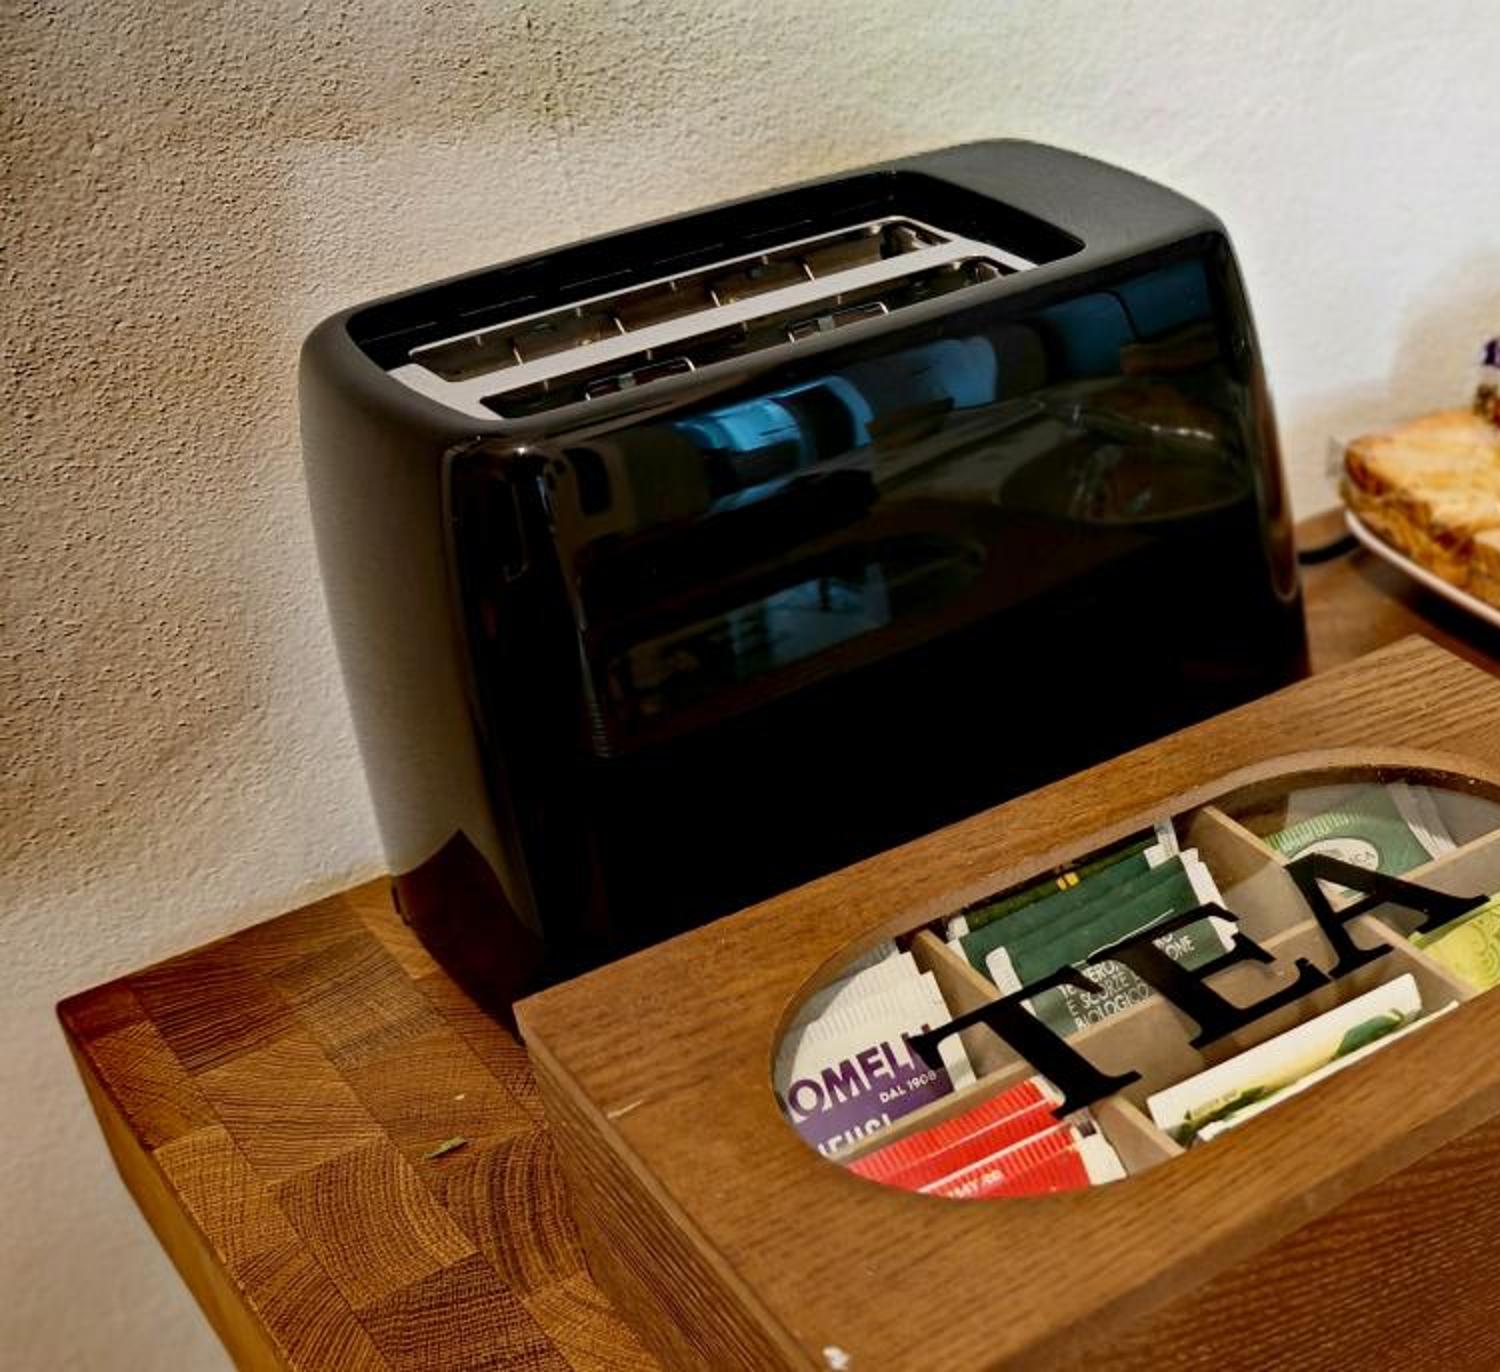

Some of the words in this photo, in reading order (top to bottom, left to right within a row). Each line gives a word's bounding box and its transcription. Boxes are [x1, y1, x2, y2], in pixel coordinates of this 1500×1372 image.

[908, 851, 1489, 1119] TEA
[879, 1084, 907, 1104] DAL
[906, 1069, 938, 1092] 1908
